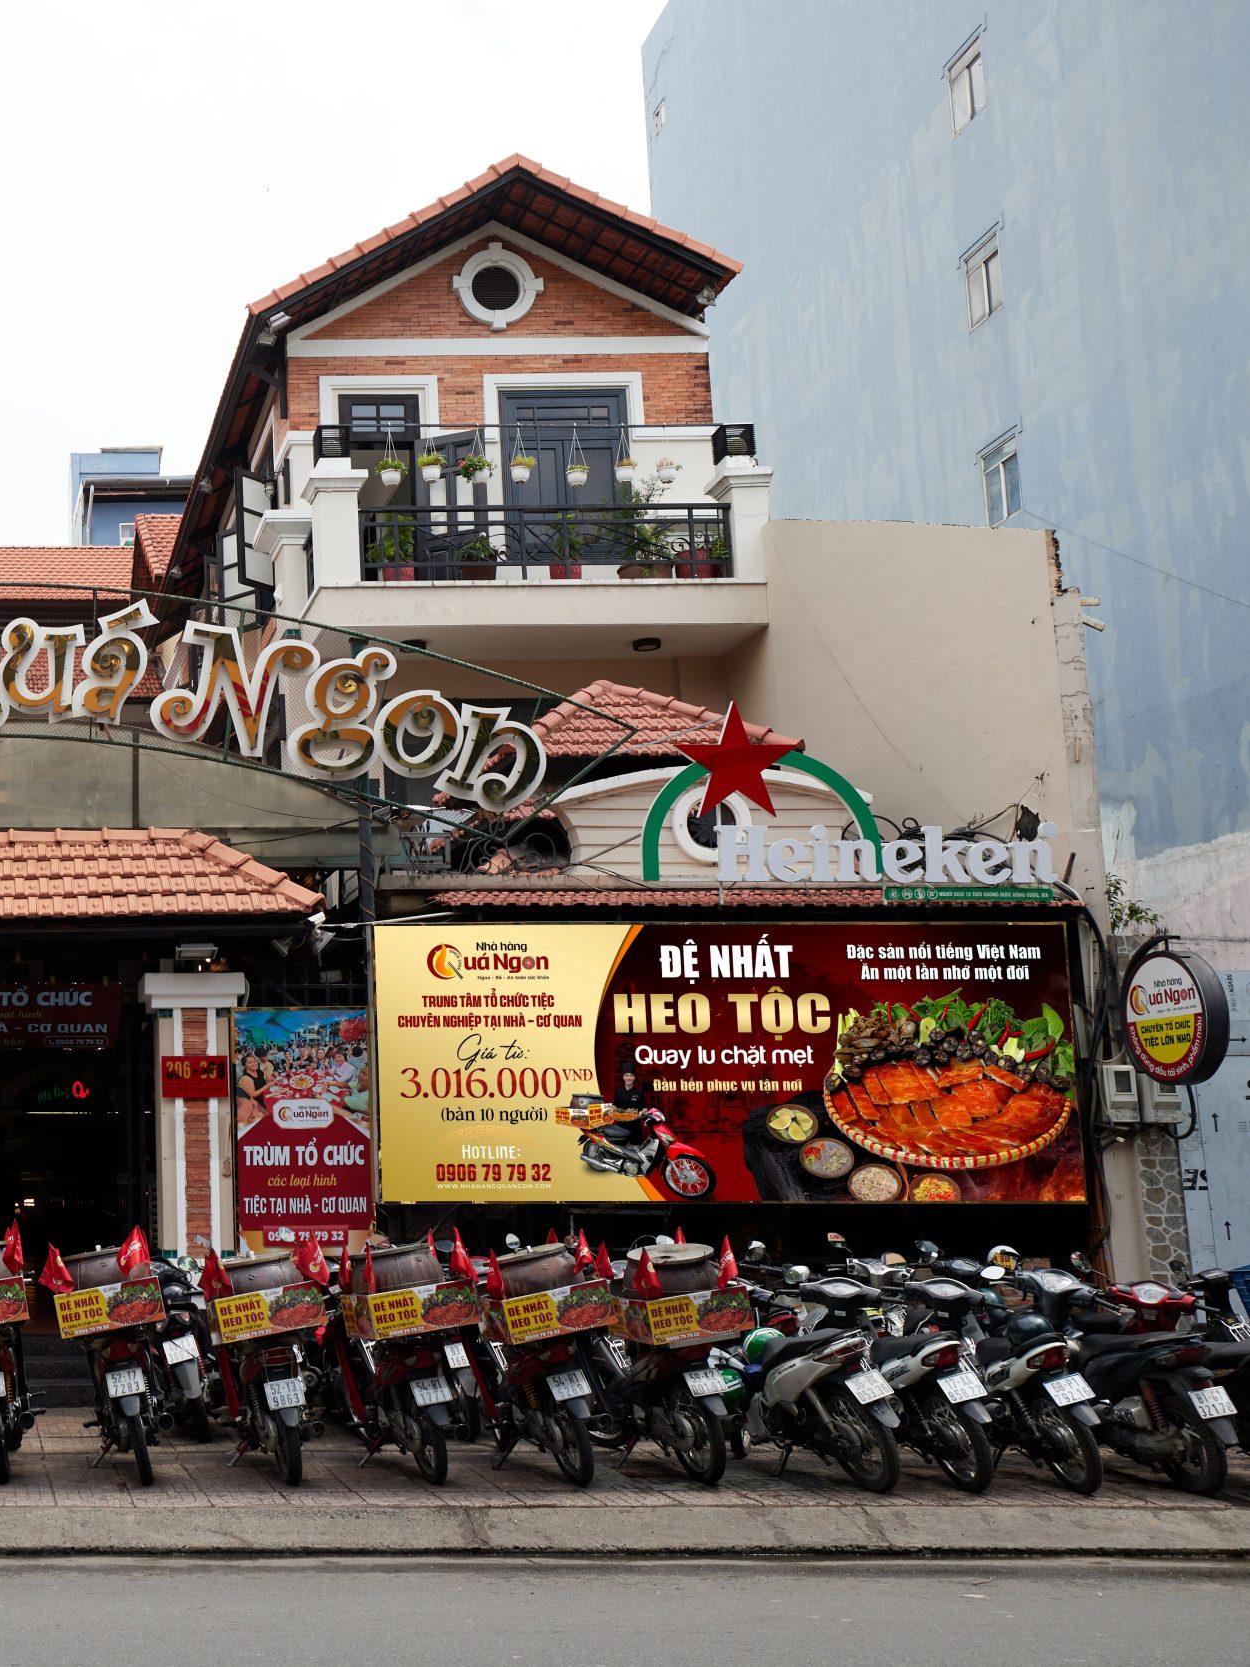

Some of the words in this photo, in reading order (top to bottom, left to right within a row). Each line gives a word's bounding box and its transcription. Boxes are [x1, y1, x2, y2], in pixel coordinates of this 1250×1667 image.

[149, 618, 547, 814] Ngon
[714, 821, 1059, 885] Heineken
[476, 942, 497, 951] Nhà
[500, 942, 527, 952] hàng
[847, 944, 874, 962] Đặc
[878, 943, 904, 959] sản
[909, 942, 931, 959] nổi
[935, 942, 973, 960] tiếng
[977, 944, 1005, 962] Việt
[1009, 945, 1041, 959] Nam
[494, 953, 549, 973] Ngon
[660, 939, 699, 984] ĐỆ
[710, 934, 793, 978] NHẤT
[861, 963, 879, 980] Ăn
[884, 965, 911, 982] một
[916, 963, 938, 980] lần
[943, 964, 971, 980] nhớ
[975, 965, 1002, 982] một
[1007, 964, 1029, 980] đời
[0, 985, 29, 1007] TỔ
[36, 988, 92, 1007] CHỨC
[422, 995, 457, 1007] TRUNG
[459, 993, 481, 1007] TÂM
[483, 988, 497, 1007] TỔ
[500, 992, 529, 1007] CHỨC
[531, 992, 554, 1010] TIỆC
[1165, 987, 1195, 1005] Ngon
[398, 1013, 440, 1027] CHUYÊN
[443, 1013, 481, 1030] NGHIỆP
[483, 1015, 501, 1030] TẠI
[504, 1013, 525, 1027] NHÀ
[536, 1014, 552, 1026] CƠ
[554, 1015, 582, 1027] QUAN
[613, 993, 710, 1034] HEO
[728, 986, 831, 1041] TỘC
[27, 1023, 51, 1033] CƠ
[57, 1023, 108, 1033] QUAN
[1141, 1022, 1163, 1034] CHUYÊN
[1166, 1019, 1173, 1030] TỔ
[1175, 1019, 1190, 1030] CHỨC
[1144, 1036, 1159, 1050] TIỆC
[1162, 1034, 1174, 1045] LỚN
[1177, 1030, 1191, 1043] NHỎ
[456, 1033, 497, 1070] Giá
[635, 1046, 691, 1069] Quay
[698, 1046, 716, 1065] lu
[721, 1045, 766, 1067] chặt
[772, 1046, 814, 1068] mẹt
[400, 1068, 561, 1098] 3.016.000
[653, 1077, 676, 1092] Đầu
[681, 1077, 701, 1093] bếp
[707, 1079, 737, 1094] phục
[741, 1081, 756, 1094] vụ
[759, 1079, 779, 1094] tận
[782, 1079, 802, 1091] nơi
[441, 1107, 475, 1123] (bàn
[480, 1108, 494, 1121] 10
[500, 1108, 548, 1124] người)
[243, 1141, 290, 1167] TRÙM
[296, 1136, 318, 1167] TỔ
[323, 1140, 365, 1166] CHỨC
[268, 1174, 287, 1187] các
[290, 1174, 311, 1189] loại
[313, 1174, 337, 1186] hình
[436, 1164, 476, 1181] 0906
[482, 1164, 501, 1181] 79
[506, 1164, 526, 1181] 79
[531, 1164, 551, 1181] 32
[244, 1195, 267, 1216] TIỆC
[270, 1197, 286, 1217] TẠI
[289, 1195, 312, 1213] NHÀ
[321, 1196, 337, 1213] CƠ
[338, 1196, 367, 1214] QUAN
[373, 1302, 387, 1314] ĐỆ
[388, 1296, 414, 1310] NHẤT
[375, 1312, 396, 1324] HEO
[397, 1308, 418, 1322] TỘC
[111, 1371, 137, 1384] 52-T7
[1051, 1377, 1079, 1393] 68-P1
[113, 1382, 140, 1395] 7283
[271, 1382, 296, 1395] 52-Y3
[1054, 1387, 1091, 1404] 792.16
[272, 1394, 300, 1407] 9863
[1198, 1402, 1234, 1418] 321.78
